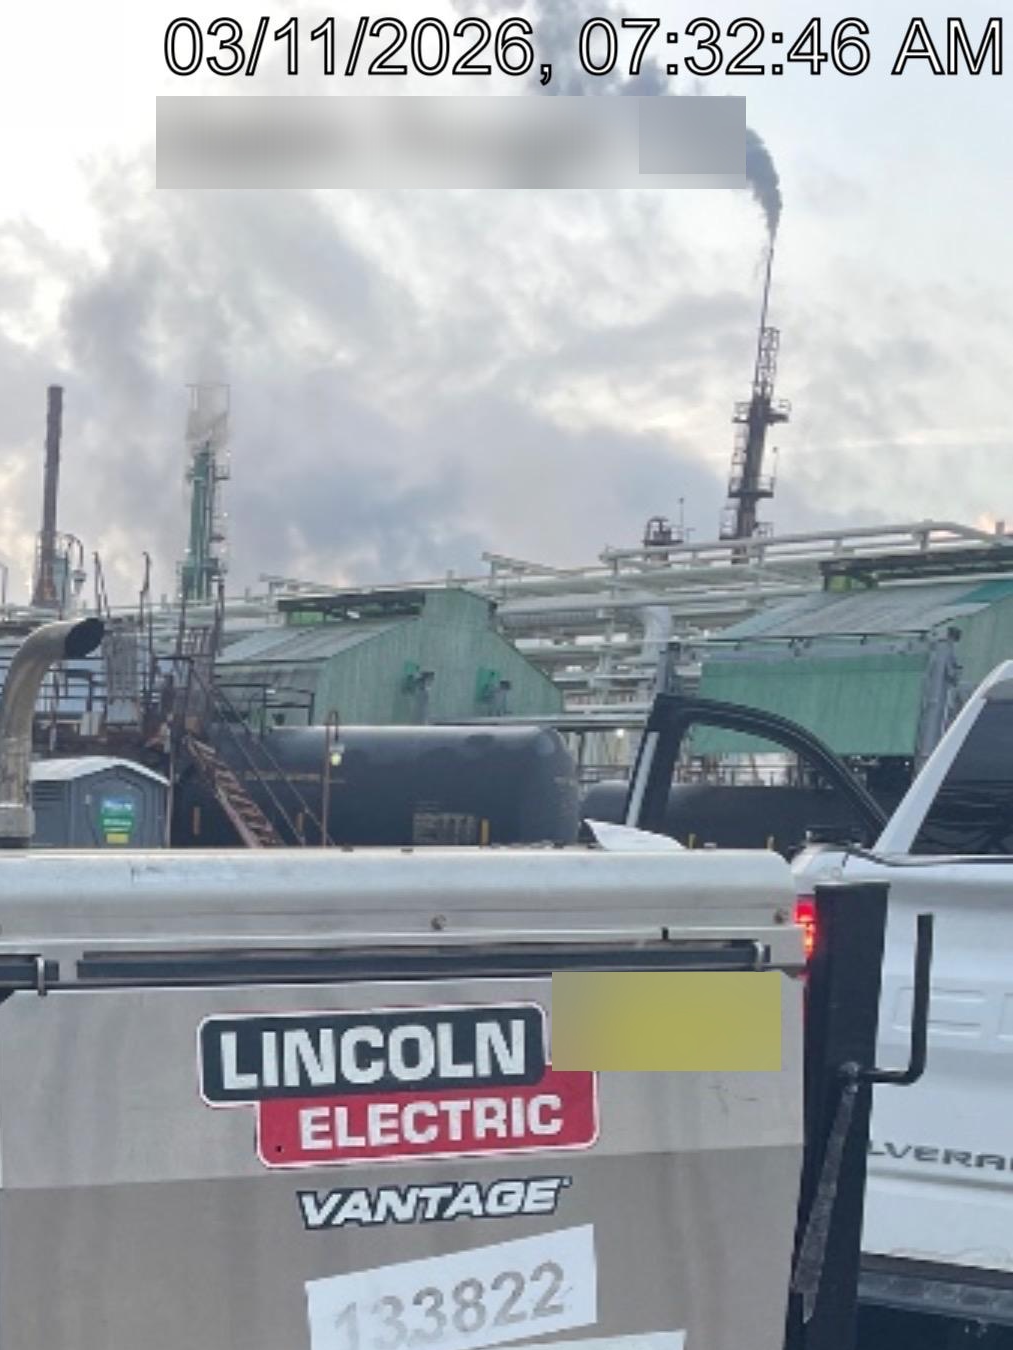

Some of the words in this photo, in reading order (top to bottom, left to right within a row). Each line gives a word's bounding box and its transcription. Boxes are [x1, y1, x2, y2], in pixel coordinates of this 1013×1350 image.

[219, 1018, 527, 1090] LINCOLN
[299, 1094, 564, 1151] ELECTRIC
[297, 1178, 563, 1231] VANTAGE
